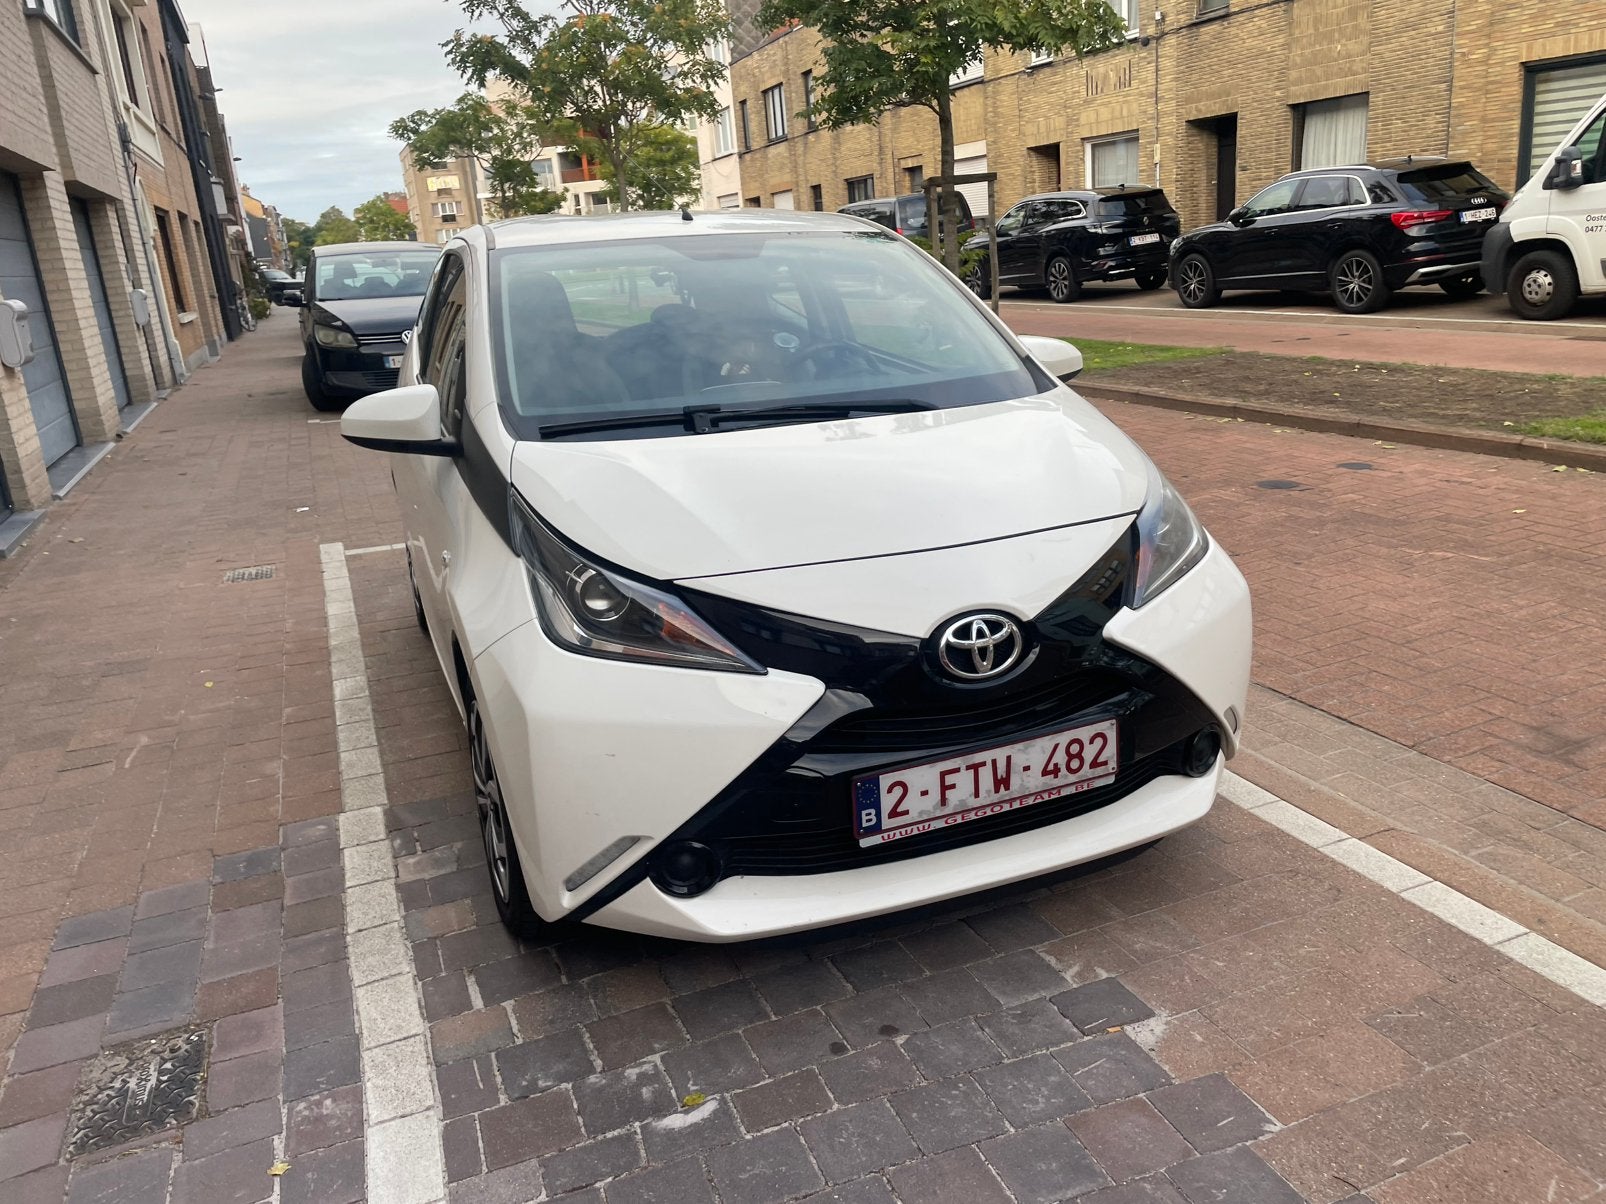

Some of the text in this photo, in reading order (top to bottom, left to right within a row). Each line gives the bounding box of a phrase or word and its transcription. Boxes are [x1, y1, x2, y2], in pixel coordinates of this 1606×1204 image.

[1584, 225, 1603, 233] 0477
[886, 731, 1109, 820] 2-FTW-482
[861, 808, 877, 828] B
